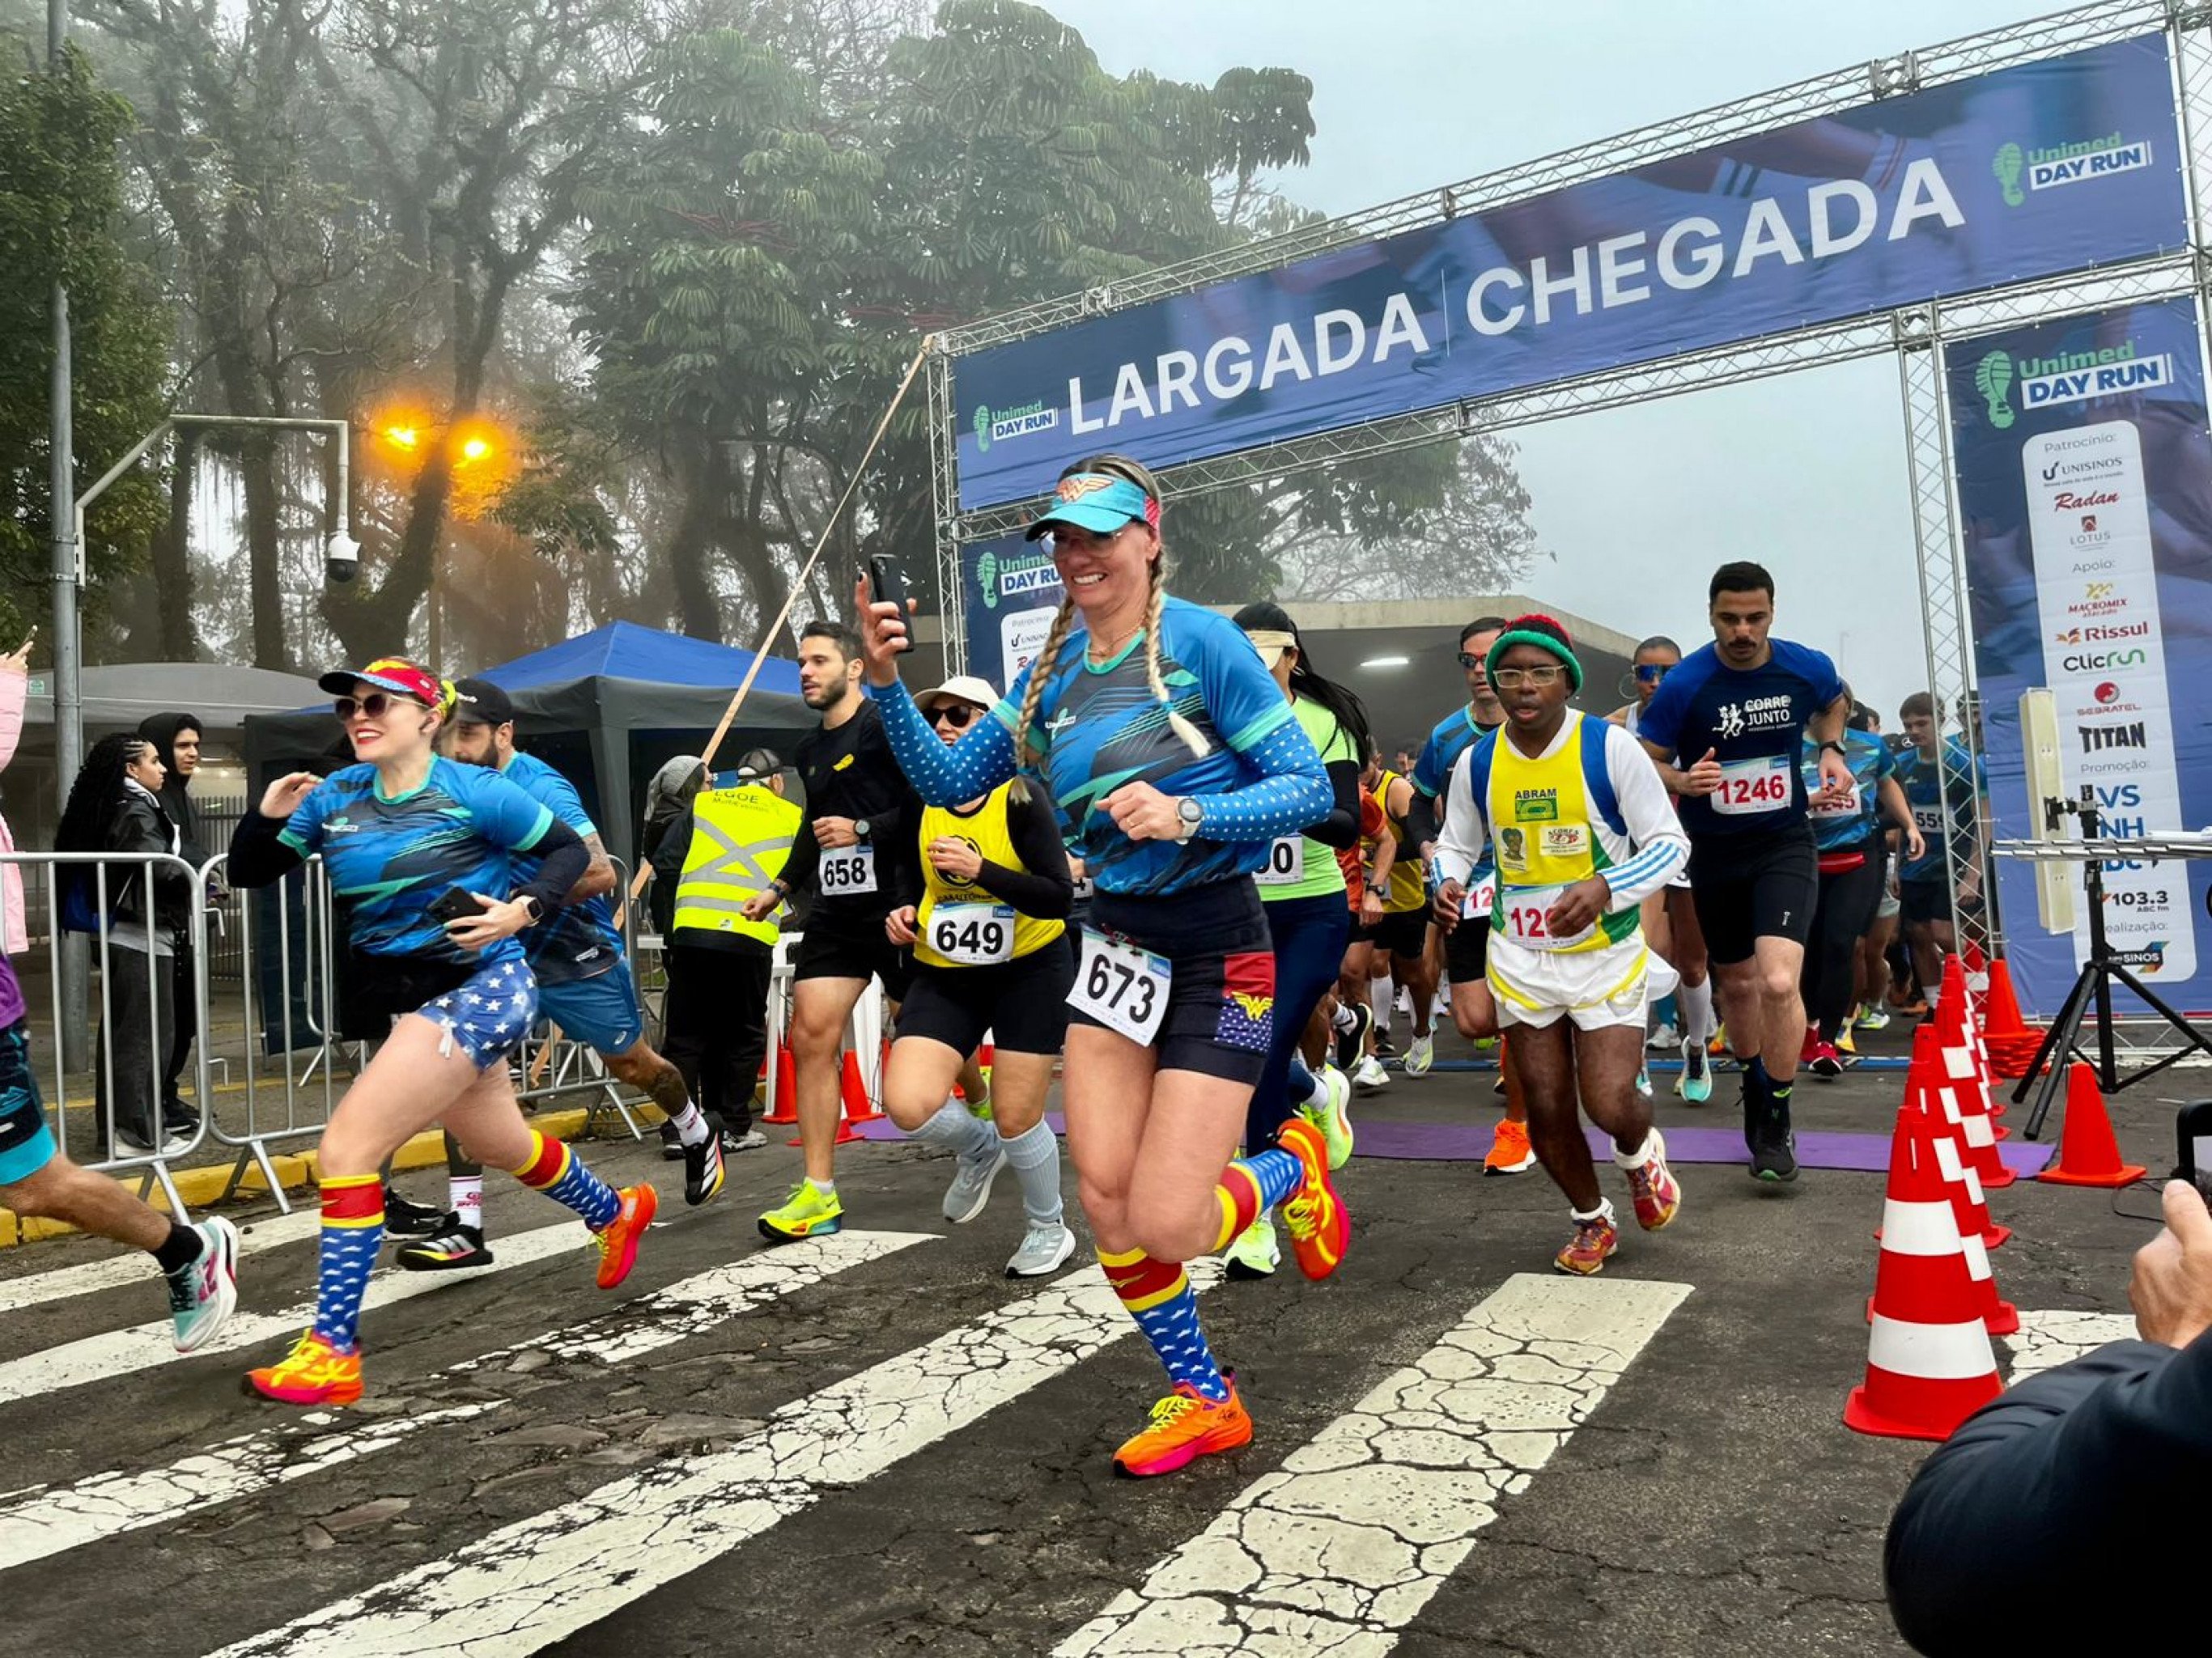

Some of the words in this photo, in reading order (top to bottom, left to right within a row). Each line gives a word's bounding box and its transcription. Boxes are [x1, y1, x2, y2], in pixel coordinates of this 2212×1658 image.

[2028, 132, 2121, 163] Unimed
[2036, 159, 2084, 184] DAY
[2091, 147, 2141, 172] RUN
[1068, 292, 1429, 435] LARGADA
[1466, 158, 1965, 335] CHEGADA
[2019, 340, 2135, 379] Unimed
[2029, 373, 2091, 403] DAY
[2096, 362, 2159, 391] RUN
[991, 400, 1042, 422] Unimed
[996, 420, 1025, 439] DAY
[1025, 412, 1052, 431] RUN
[2061, 457, 2122, 475] UNISINOS
[2054, 490, 2120, 511] Radan
[2070, 531, 2111, 545] LOTUS
[1000, 553, 1051, 573] Unime
[2073, 559, 2116, 573] Apoio:
[1005, 570, 1037, 591] DAY
[1040, 566, 1061, 584] RU
[2068, 599, 2127, 613] MACROMIX
[2085, 621, 2149, 641] Rissul
[1743, 695, 1792, 713] CORRE
[1747, 709, 1790, 726] JUNTO
[2078, 721, 2146, 753] TITAN
[2081, 760, 2150, 774] Promoção:
[1515, 788, 1557, 799] ABRAM
[1717, 774, 1785, 804] 1246
[2096, 785, 2141, 808] VS
[2099, 816, 2144, 838] NH
[824, 857, 866, 887] 658
[1470, 886, 1495, 909] 12
[2112, 891, 2168, 905] 103.3
[1510, 908, 1555, 937] 12
[2105, 922, 2168, 932] ealização:
[936, 919, 1004, 955] 649
[2123, 952, 2159, 963] SINOS
[1088, 953, 1156, 1024] 673
